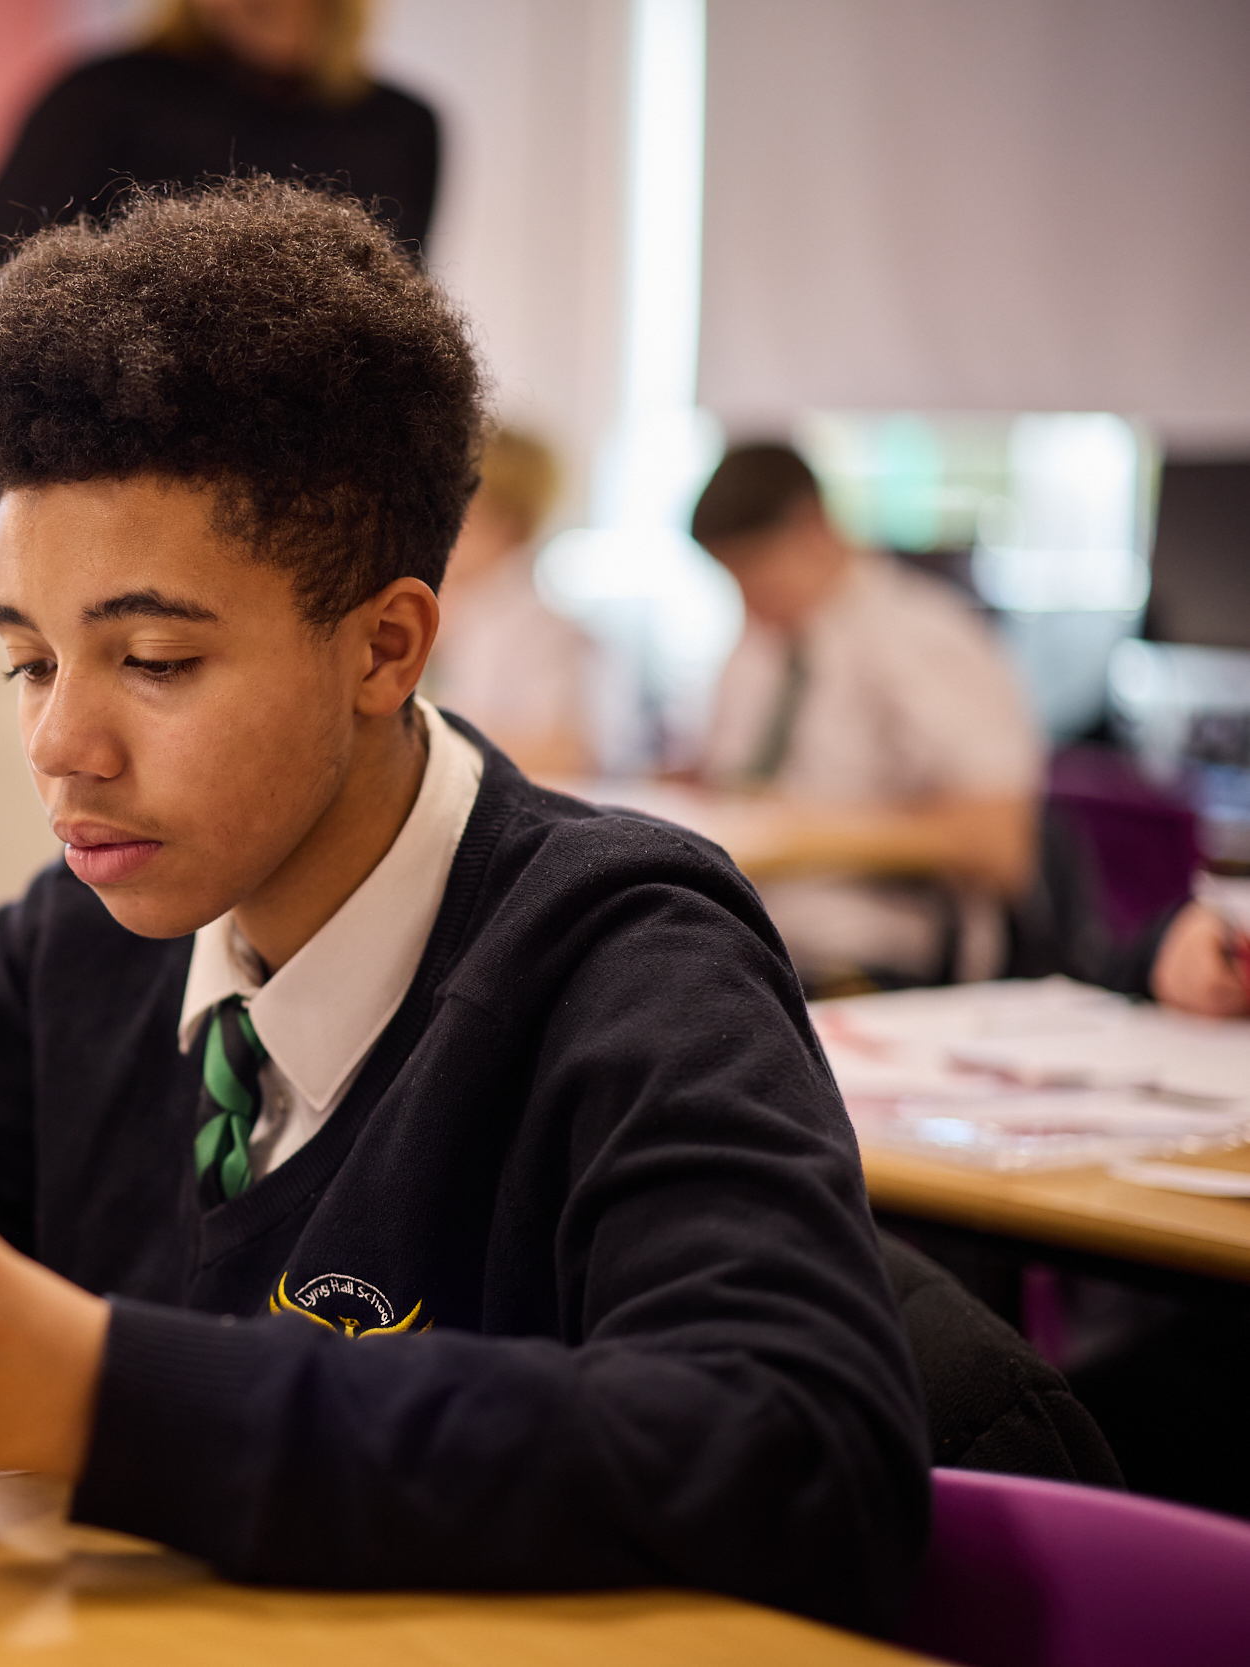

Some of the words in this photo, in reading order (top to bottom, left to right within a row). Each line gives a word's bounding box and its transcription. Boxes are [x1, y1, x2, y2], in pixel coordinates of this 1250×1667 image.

[298, 1285, 330, 1307] Lyng
[330, 1279, 354, 1295] Hall
[356, 1286, 390, 1325] School
